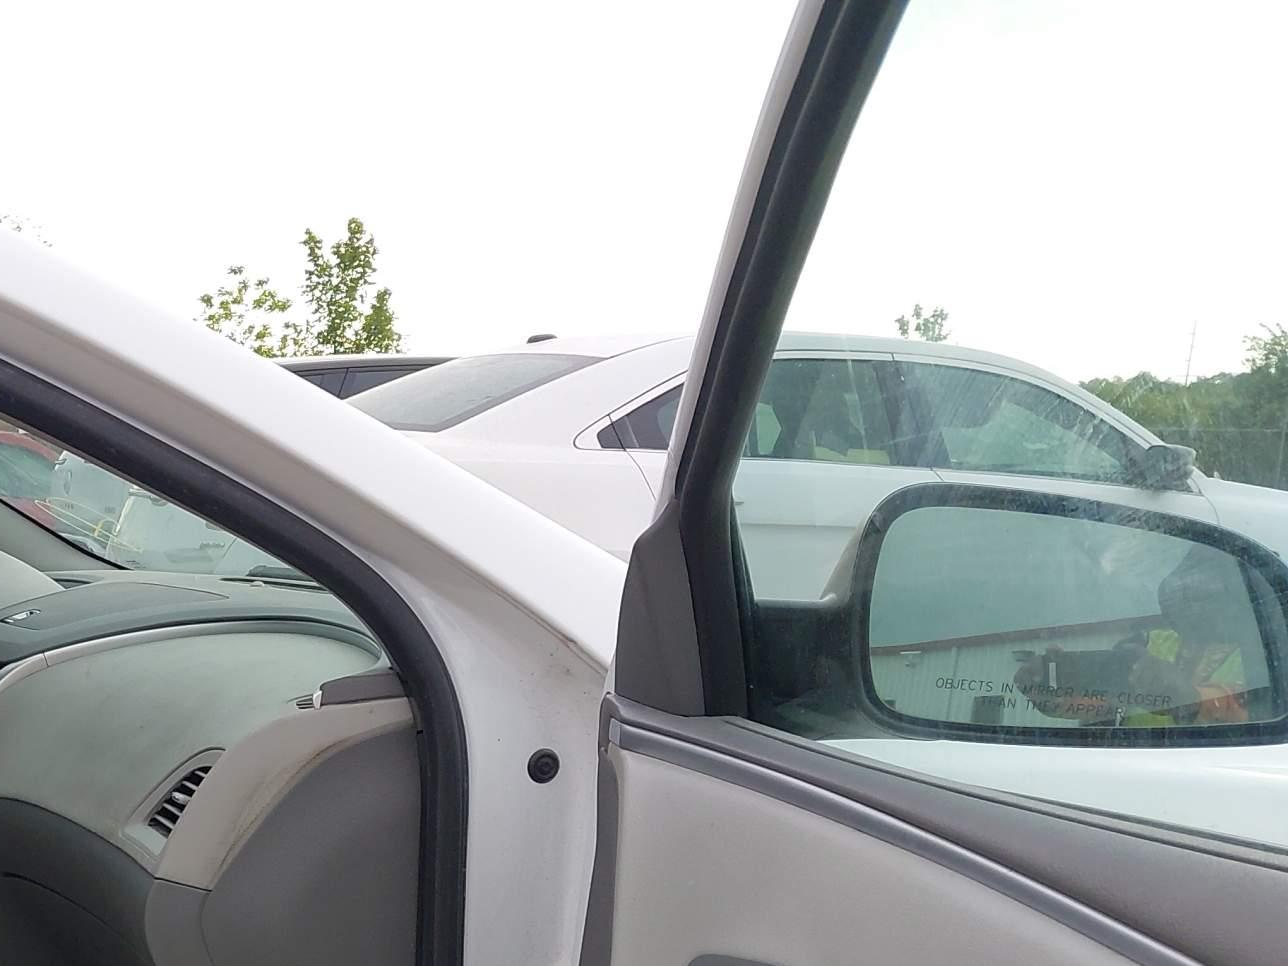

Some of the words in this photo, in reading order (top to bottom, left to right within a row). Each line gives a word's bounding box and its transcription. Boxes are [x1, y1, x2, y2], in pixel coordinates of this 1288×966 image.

[935, 677, 994, 693] OBJECTS
[1001, 682, 1014, 694] IN
[1023, 684, 1075, 698] MIRROR
[1082, 688, 1108, 702] ARE
[1118, 691, 1173, 706] CLOSER
[1025, 698, 1062, 713] THEY
